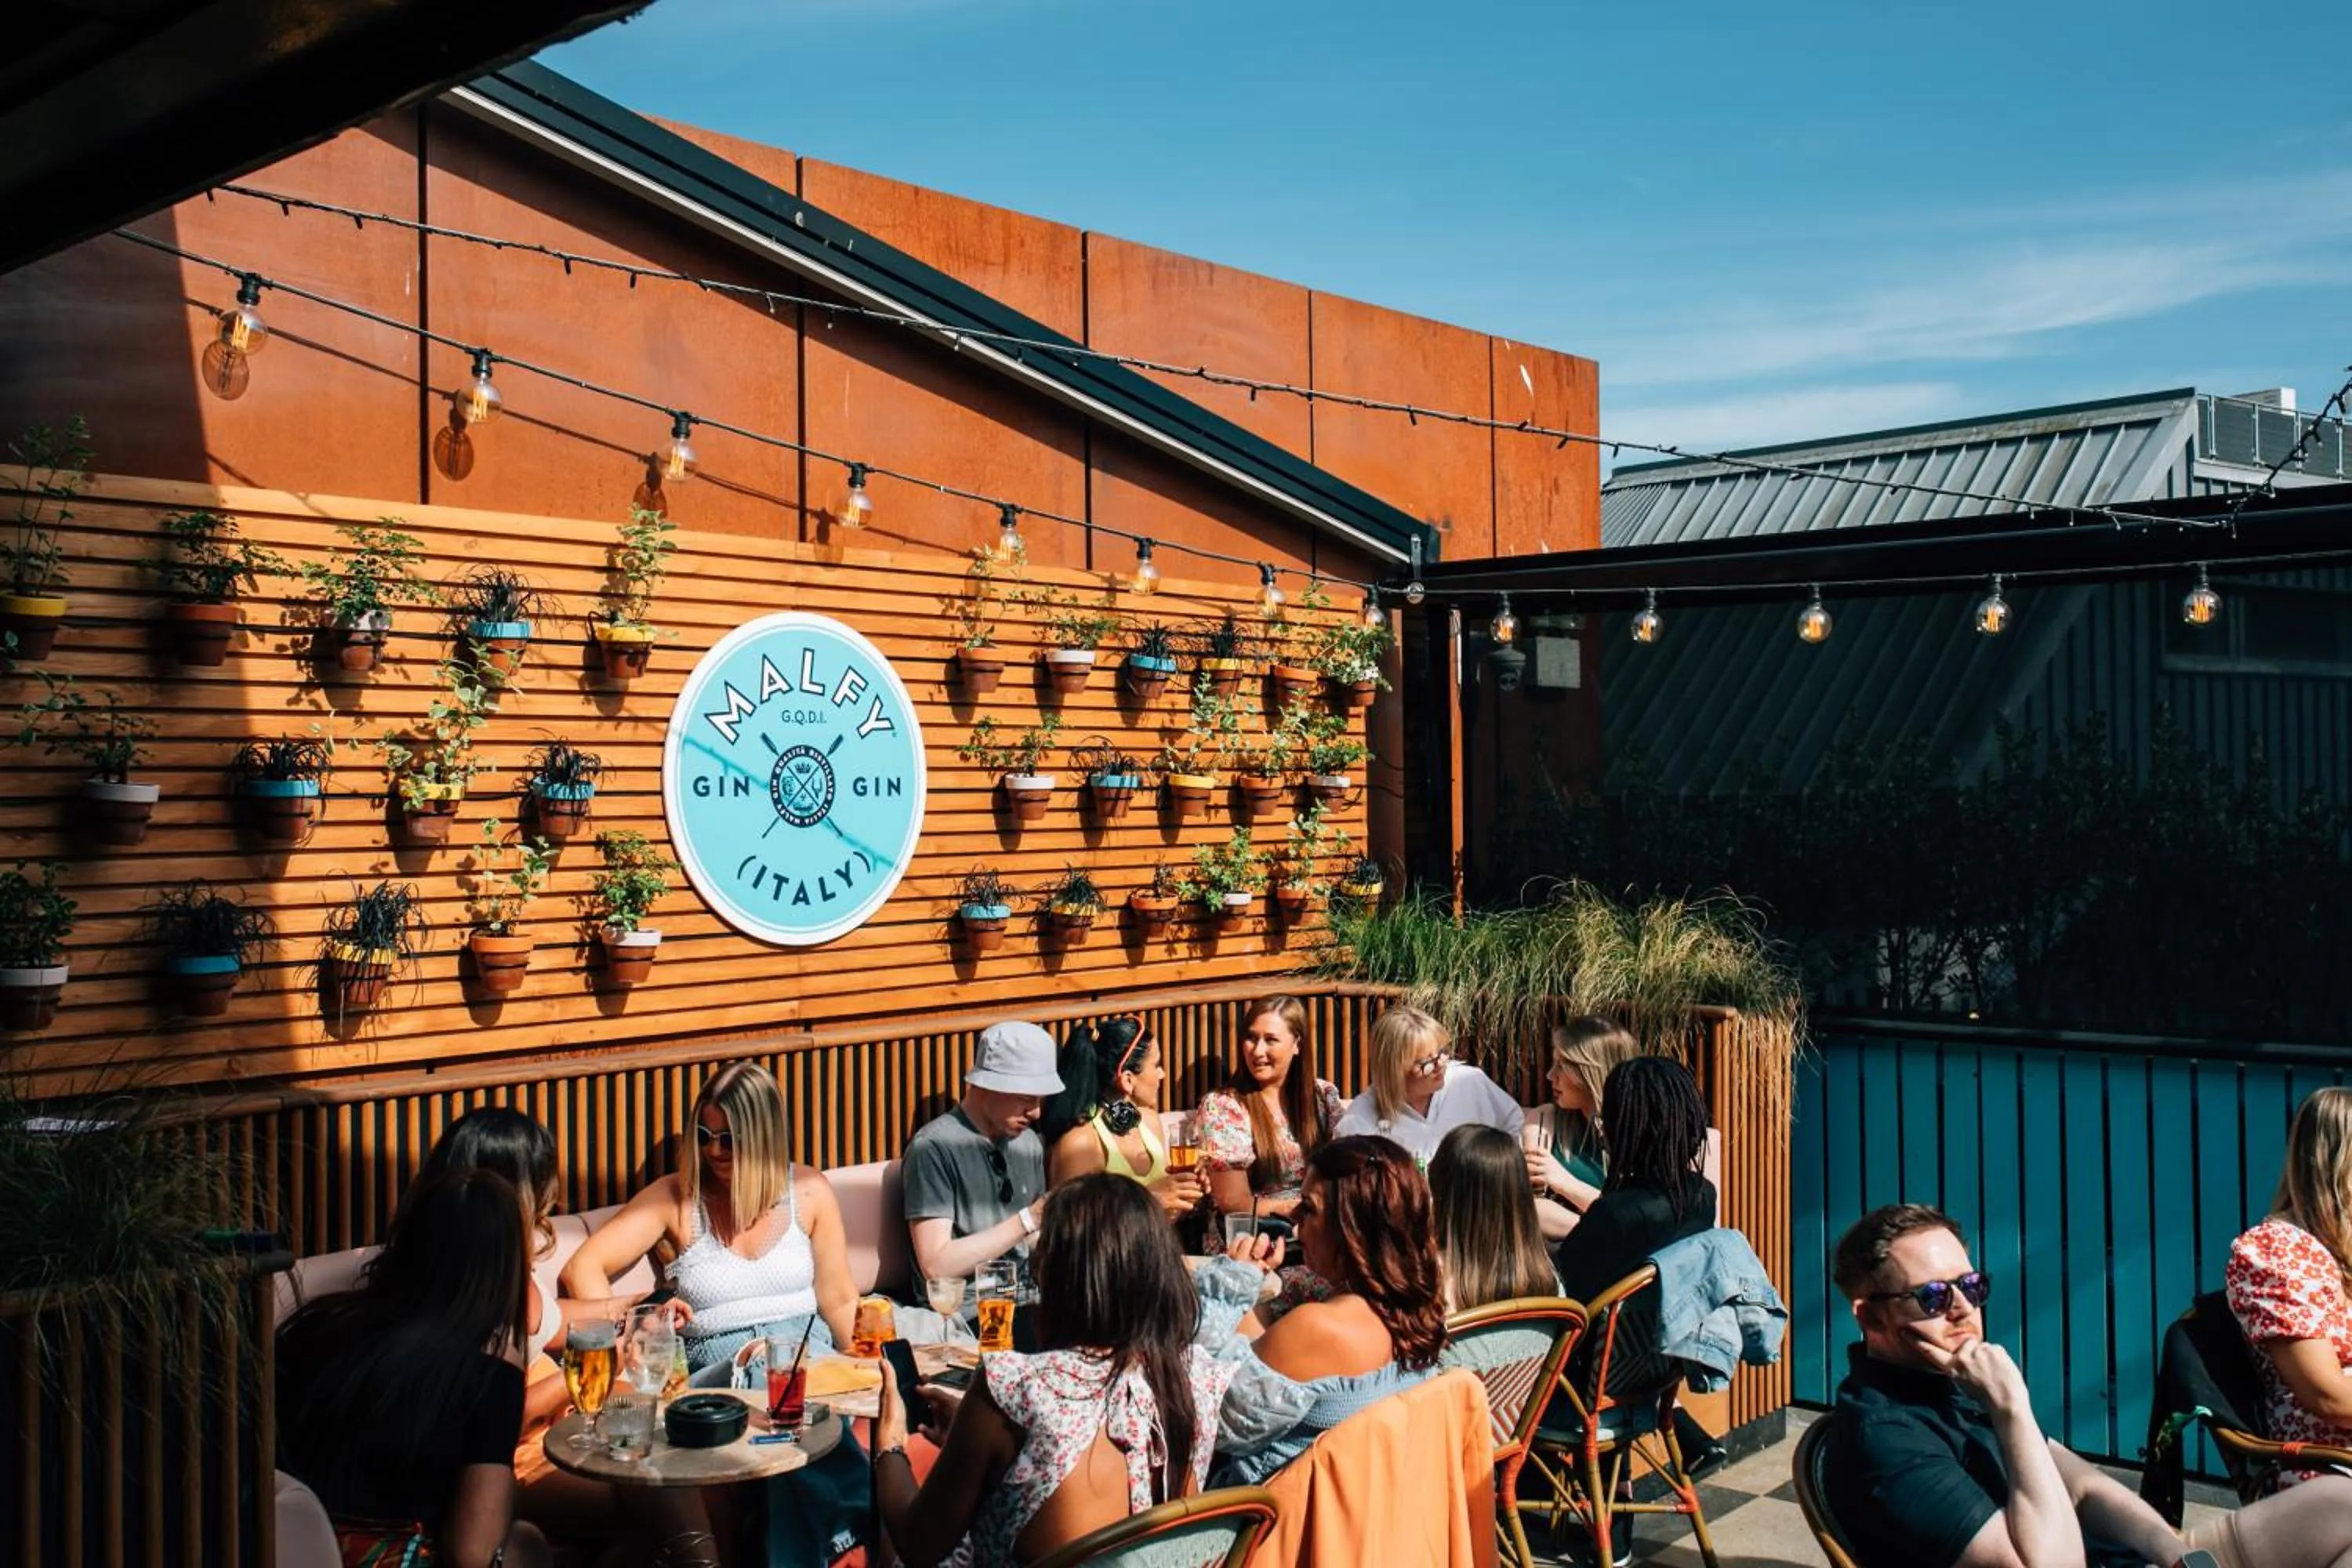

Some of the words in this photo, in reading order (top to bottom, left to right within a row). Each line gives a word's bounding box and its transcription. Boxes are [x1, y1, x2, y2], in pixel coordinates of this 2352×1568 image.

[704, 648, 895, 745] MALFY
[782, 710, 827, 725] G.Q.D.I.
[693, 775, 750, 797] GIN
[852, 776, 901, 797] GIN
[737, 851, 871, 906] (ITALY)
